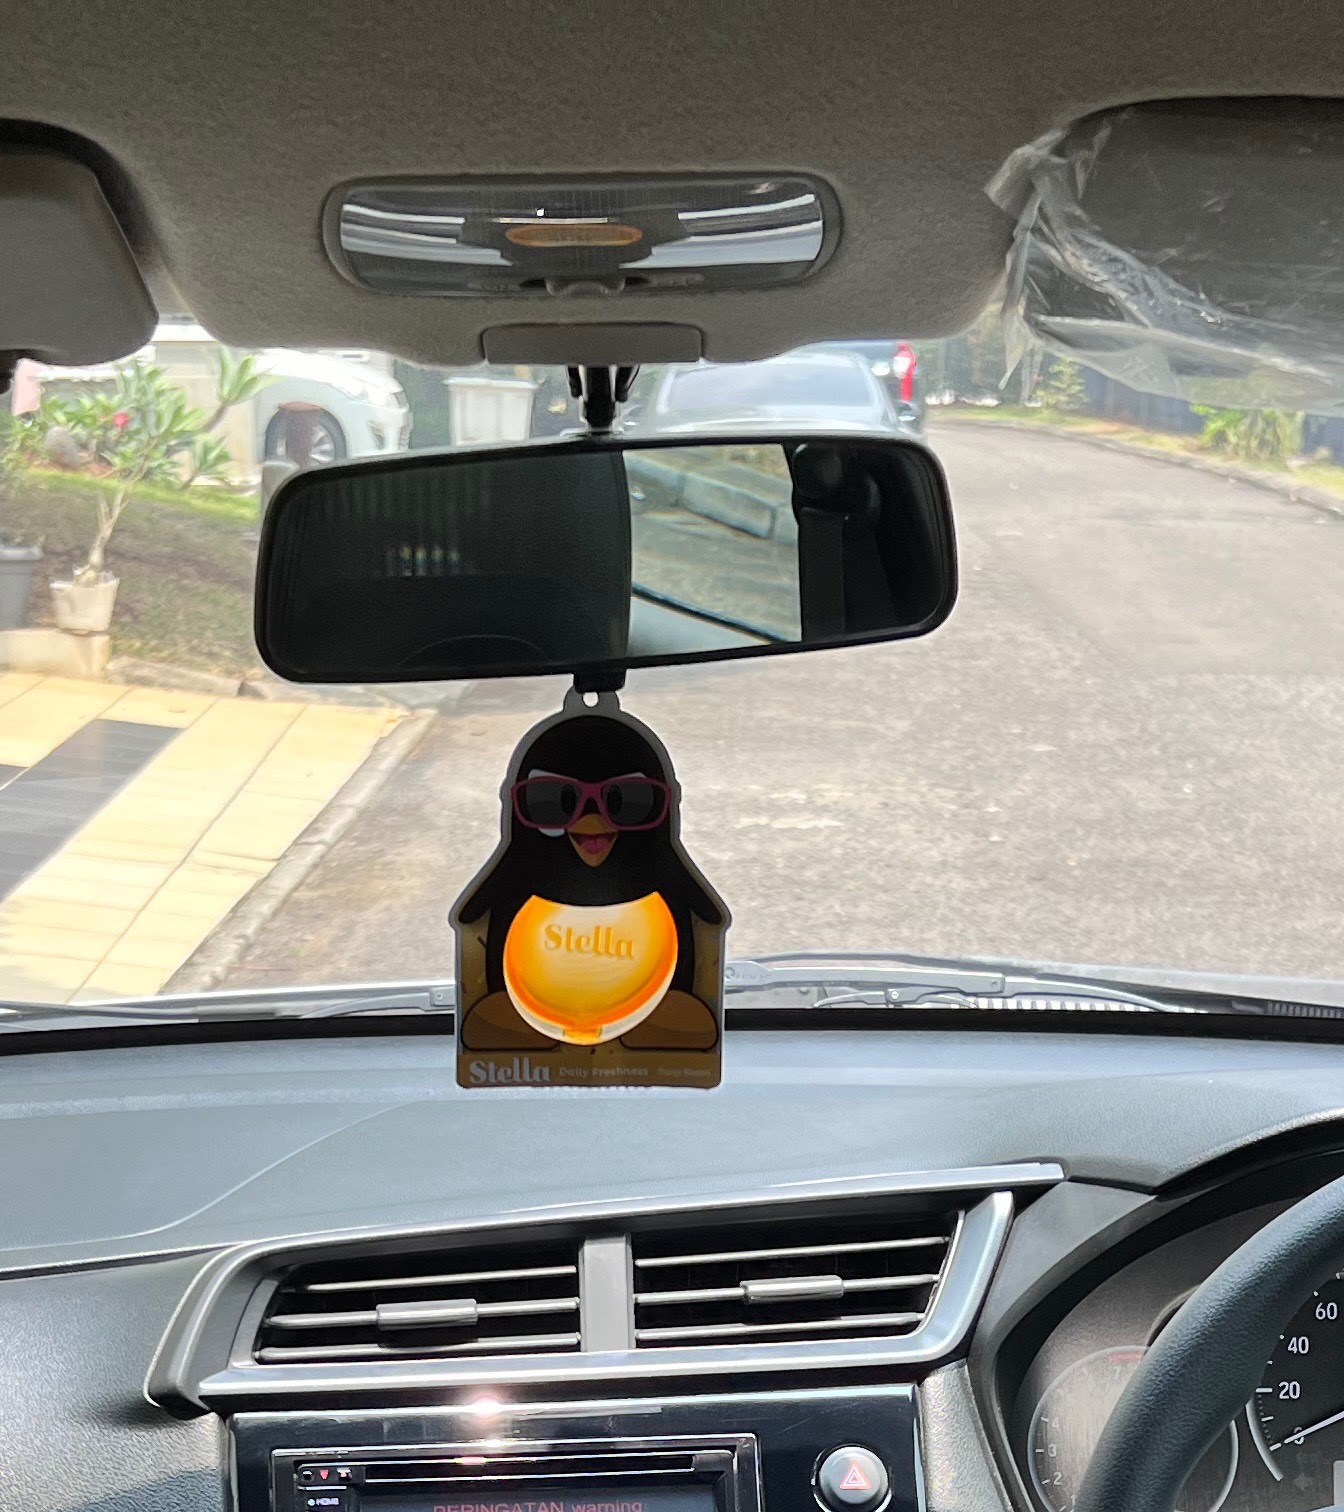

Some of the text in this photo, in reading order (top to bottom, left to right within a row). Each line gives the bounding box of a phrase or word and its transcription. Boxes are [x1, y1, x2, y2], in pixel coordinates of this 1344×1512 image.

[544, 924, 636, 961] Stella
[469, 1057, 551, 1083] Stella
[1315, 1302, 1338, 1320] 60
[1287, 1336, 1310, 1354] 40
[1278, 1381, 1301, 1400] 20
[1048, 1444, 1057, 1458] 3
[1053, 1472, 1062, 1485] 2
